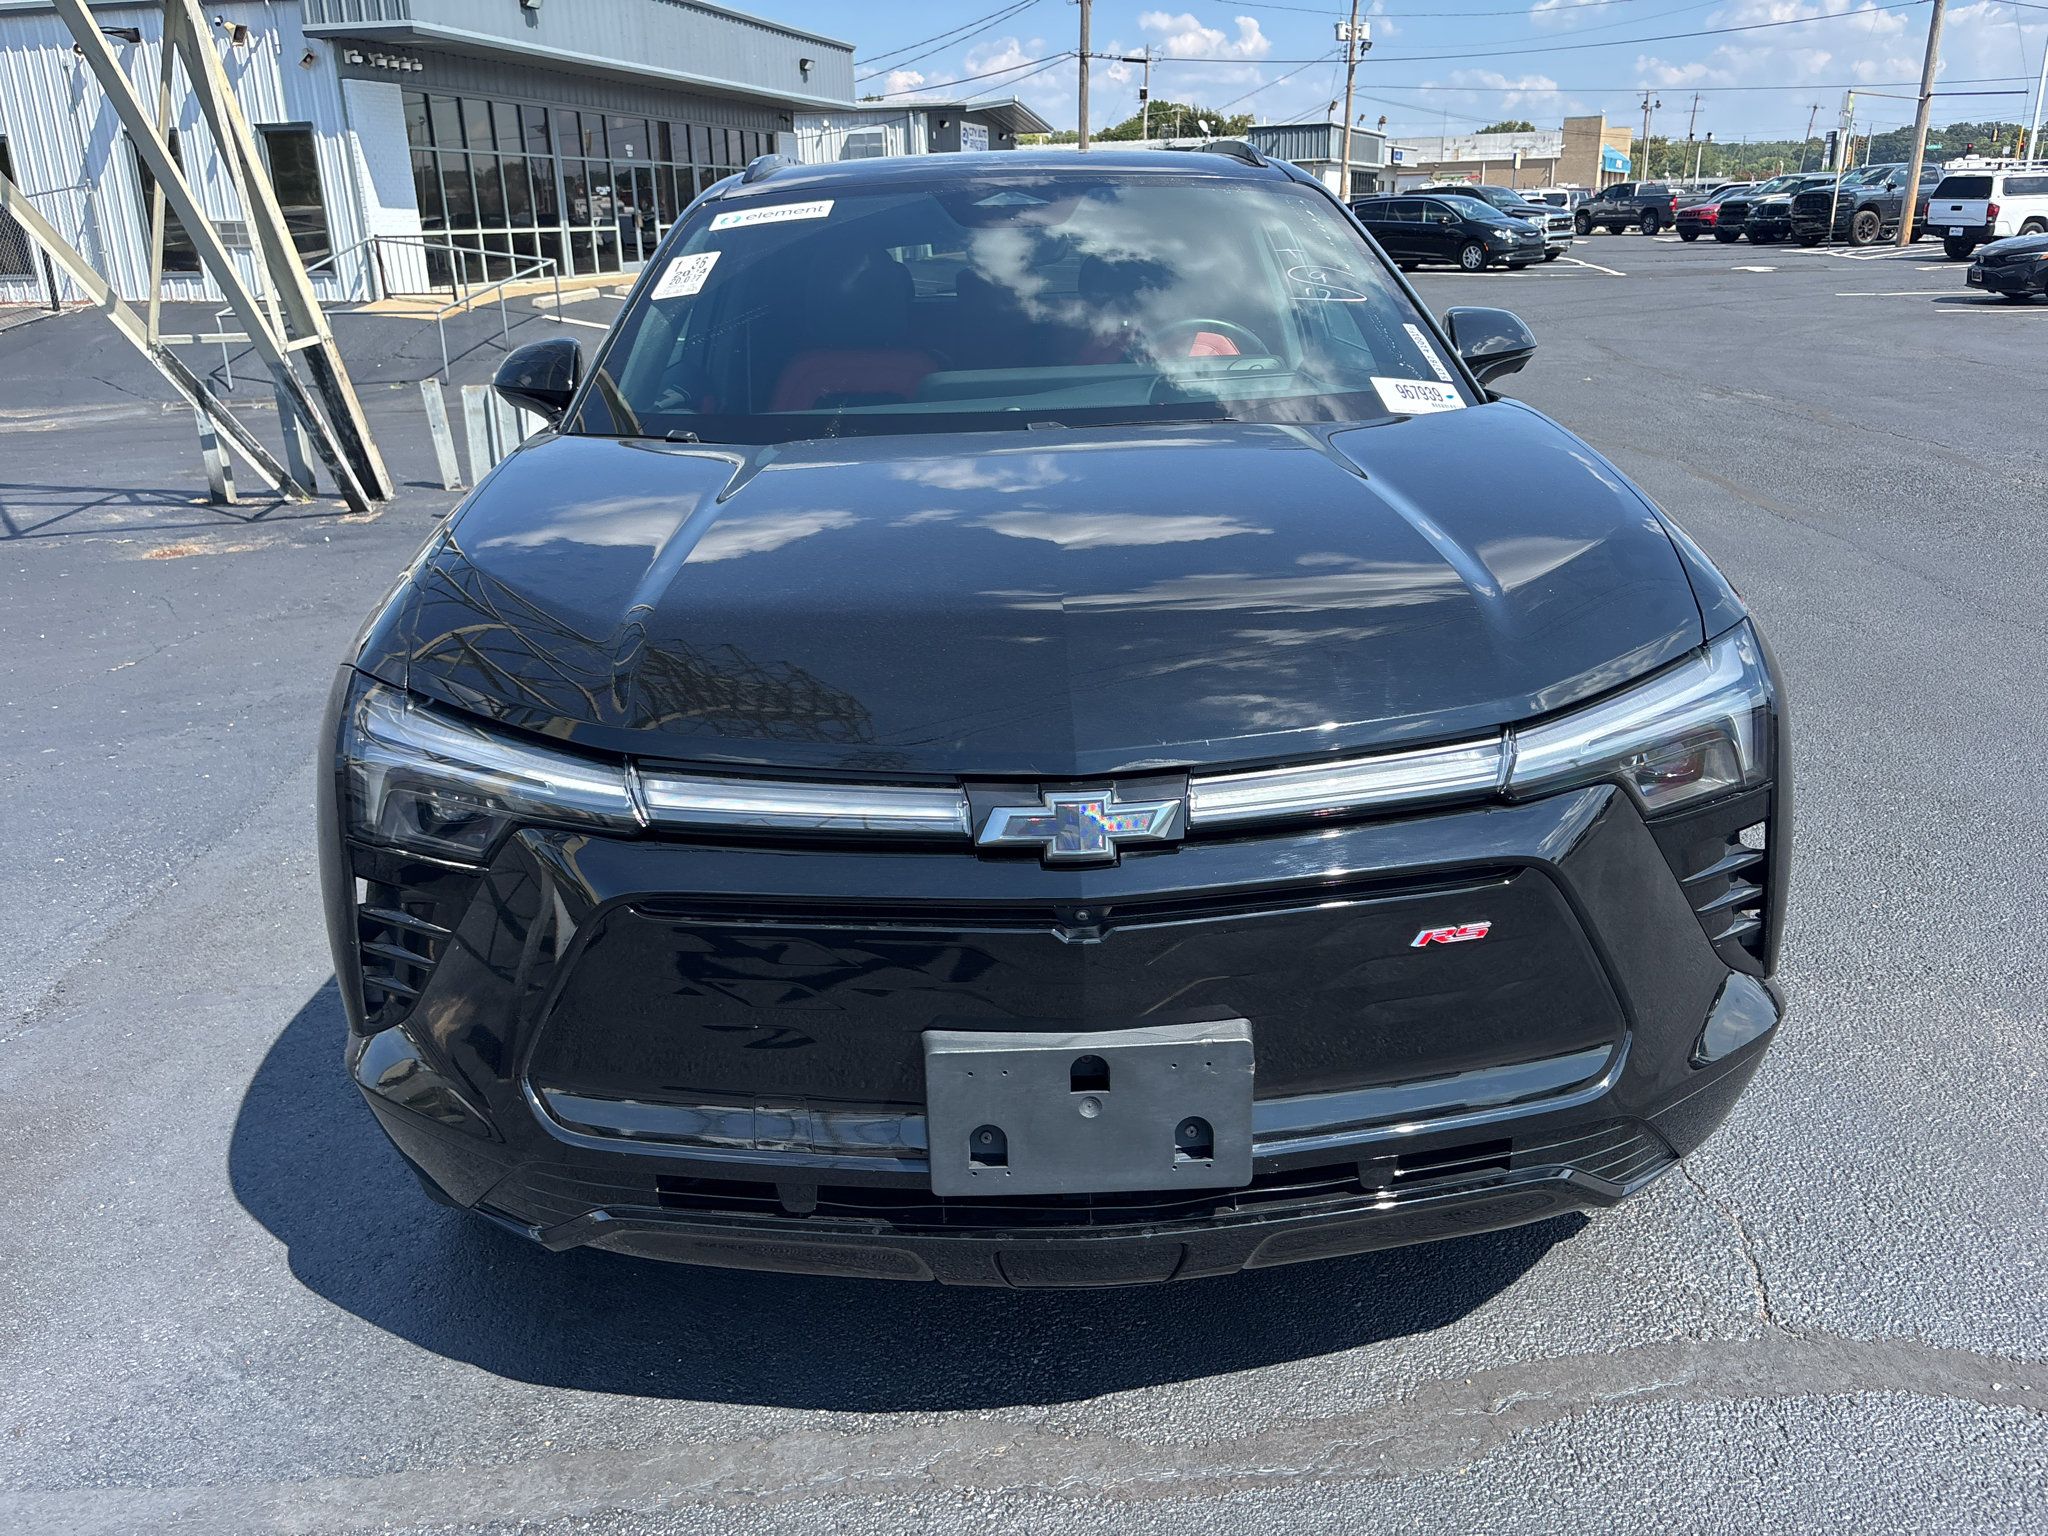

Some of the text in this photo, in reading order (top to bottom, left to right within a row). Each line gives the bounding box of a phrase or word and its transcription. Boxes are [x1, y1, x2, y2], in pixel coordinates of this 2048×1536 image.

[745, 205, 824, 221] element
[1395, 383, 1444, 402] 967939
[1410, 921, 1492, 947] RS
